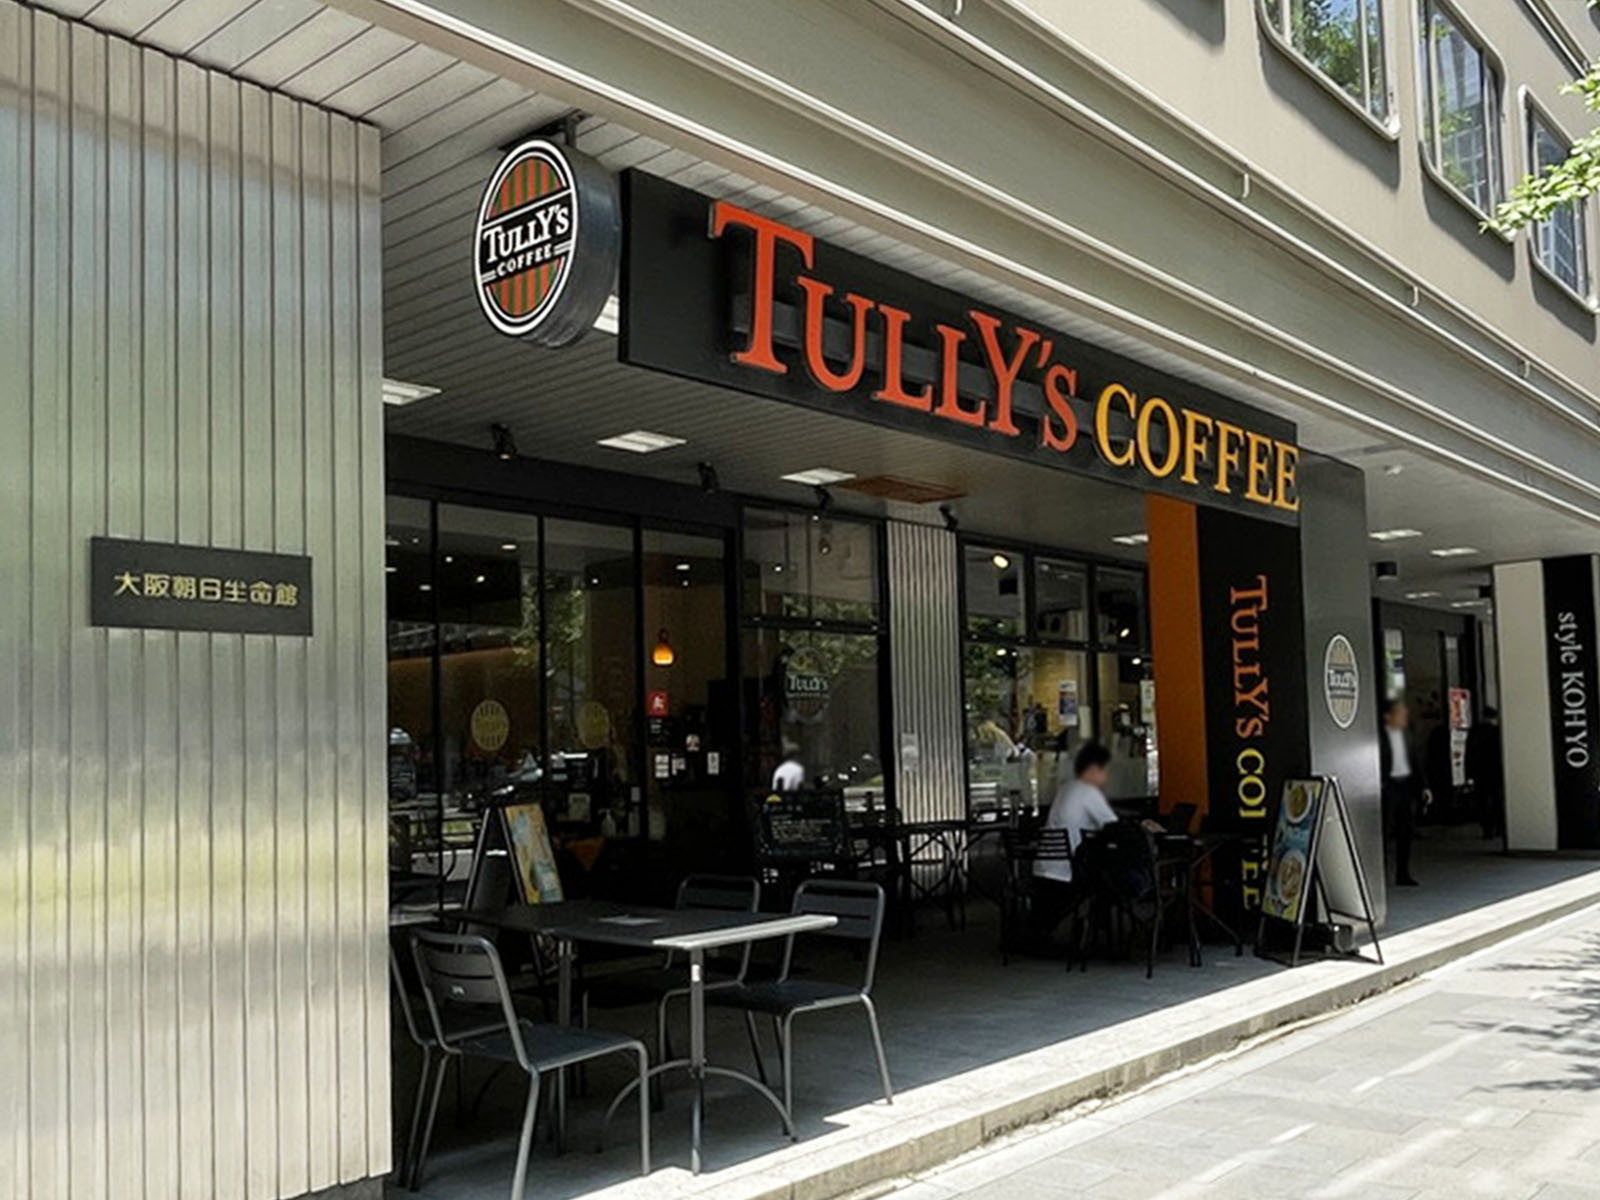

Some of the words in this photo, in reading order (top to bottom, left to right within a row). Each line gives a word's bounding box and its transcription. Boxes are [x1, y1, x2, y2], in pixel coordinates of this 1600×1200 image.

[496, 243, 553, 277] COFFEE
[1095, 382, 1299, 512] COFFEE
[113, 571, 299, 607] 大阪朝日生命館
[1554, 611, 1582, 665] style
[1561, 671, 1590, 769] KOHYO
